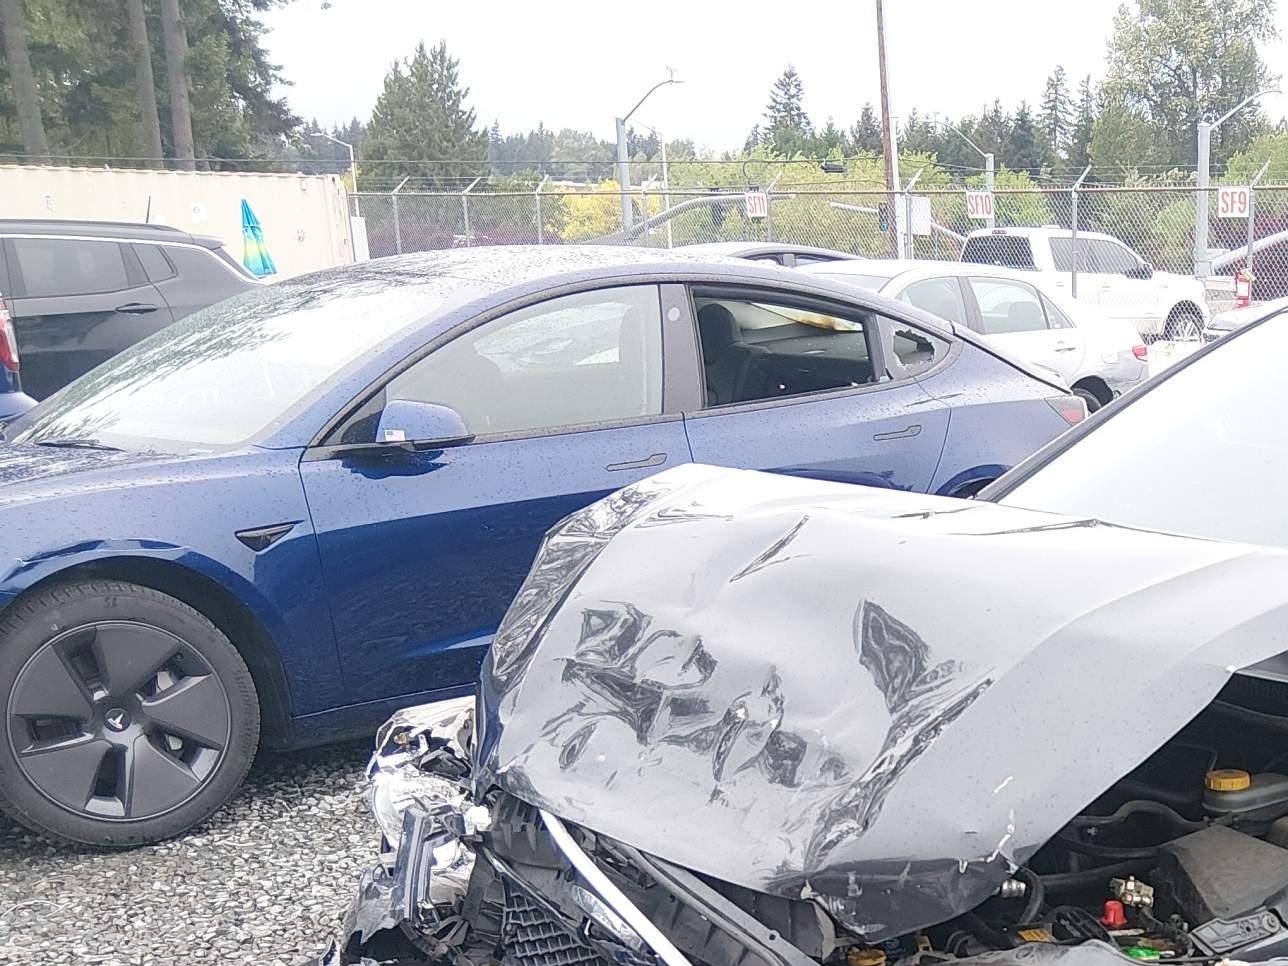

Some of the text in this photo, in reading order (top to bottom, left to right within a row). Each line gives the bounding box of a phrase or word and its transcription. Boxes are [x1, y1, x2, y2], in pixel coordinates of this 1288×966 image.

[747, 195, 766, 214] SF11
[968, 194, 992, 215] SF10
[1221, 191, 1247, 214] SF9
